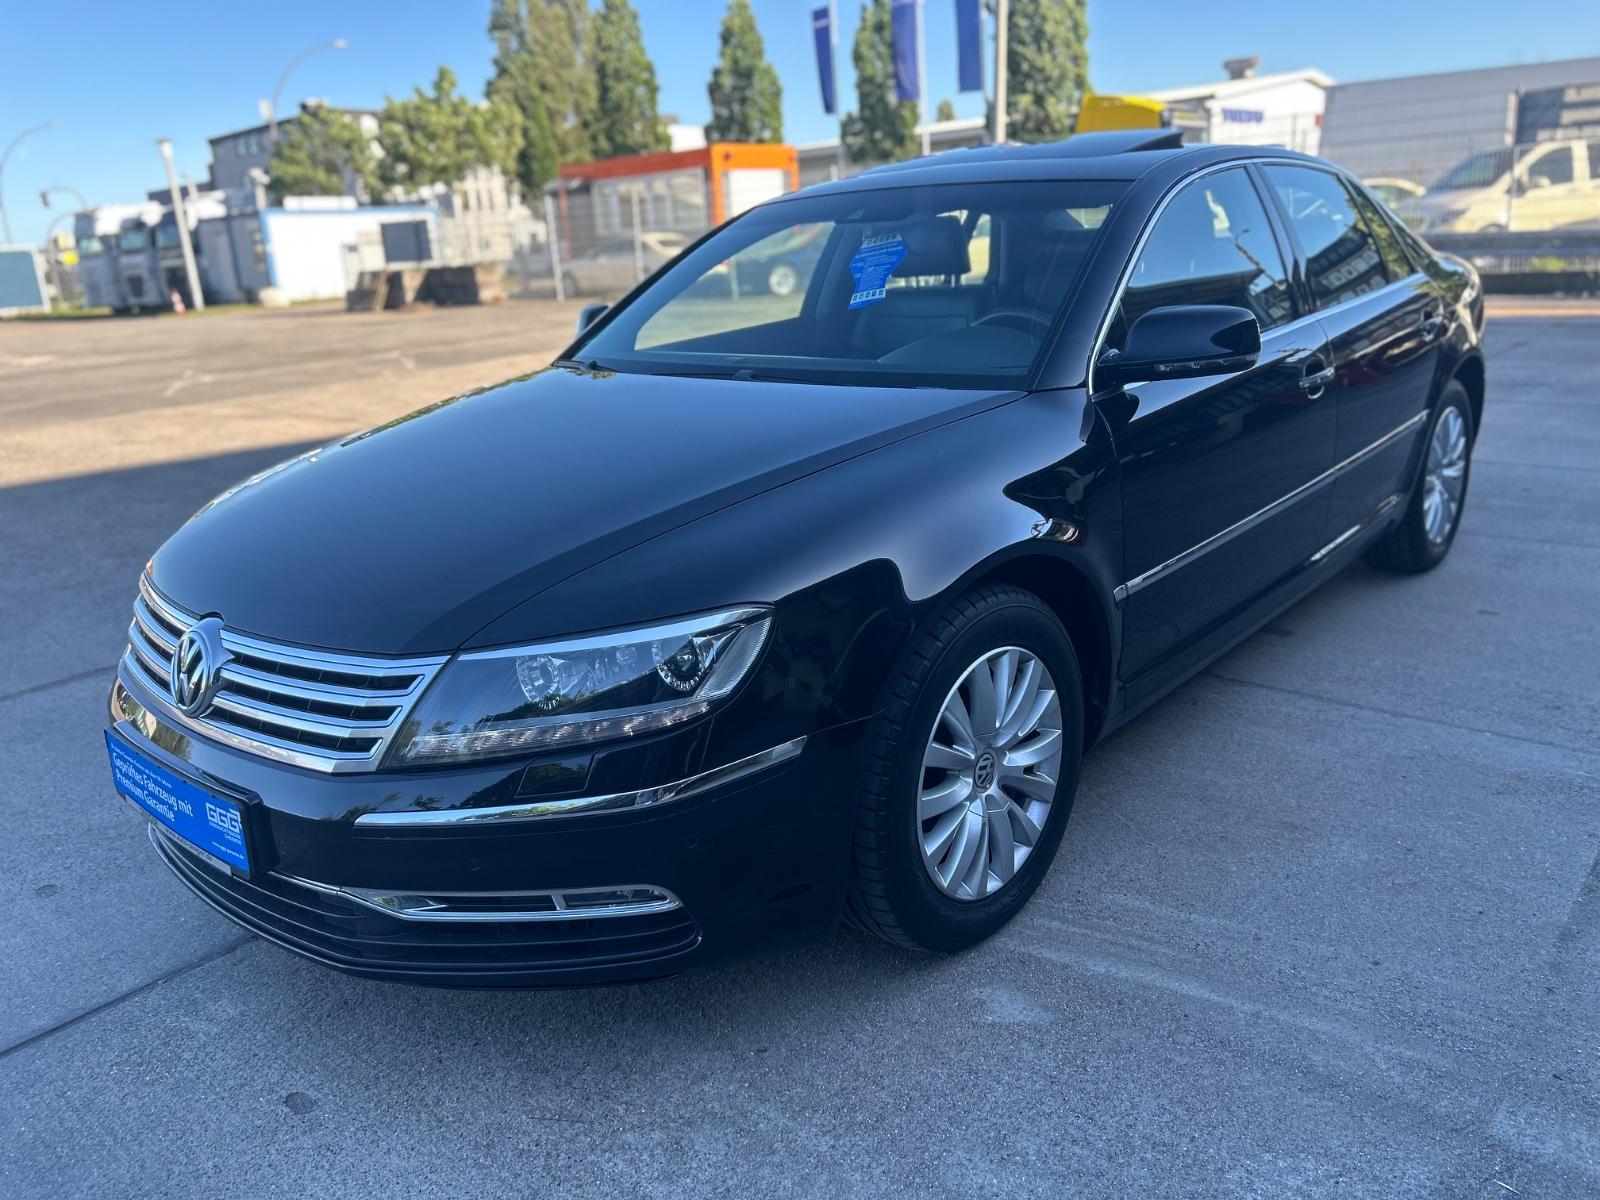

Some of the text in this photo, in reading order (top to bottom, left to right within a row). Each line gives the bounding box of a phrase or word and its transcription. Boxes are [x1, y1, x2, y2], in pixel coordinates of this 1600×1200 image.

[112, 752, 144, 785] Geprüftes
[143, 773, 178, 811] Fahrzeug
[178, 800, 194, 817] mit
[115, 768, 175, 822] Premium Garantie
[205, 802, 241, 833] GGG
